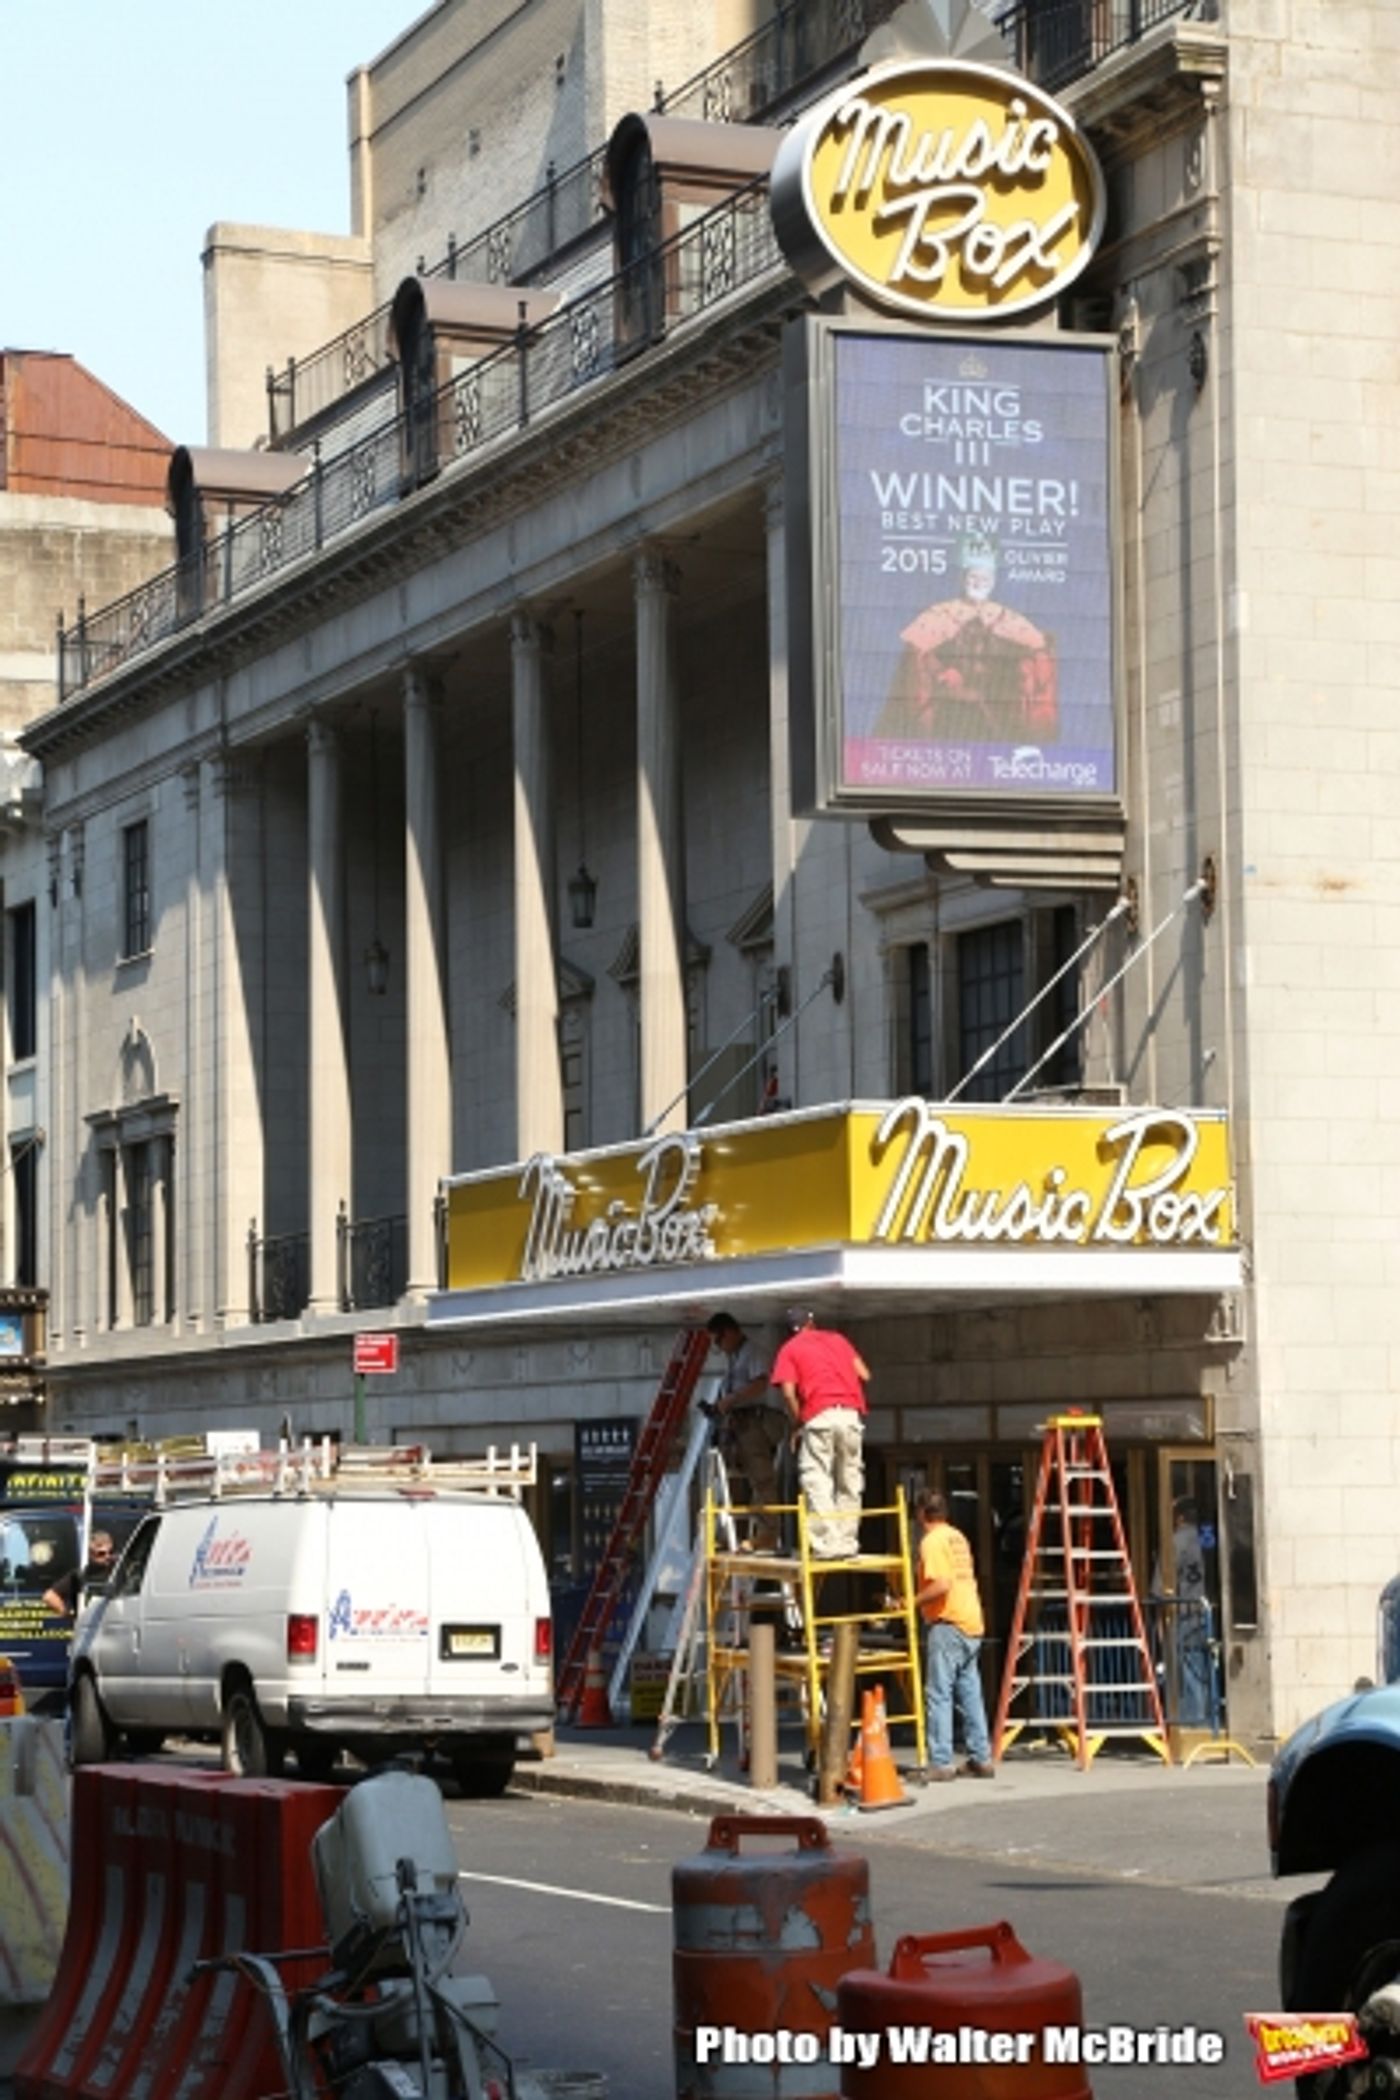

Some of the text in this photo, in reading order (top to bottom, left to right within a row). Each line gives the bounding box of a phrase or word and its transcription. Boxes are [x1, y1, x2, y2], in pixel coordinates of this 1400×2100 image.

[837, 98, 1057, 185] Music
[878, 184, 1080, 288] Box
[923, 384, 1021, 417] KING
[899, 412, 1044, 443] CHARLES
[954, 440, 990, 467] III
[870, 470, 1080, 516] WINNER!
[881, 511, 1066, 537] BEST NEW PLAY
[880, 547, 948, 575] 2015
[906, 762, 946, 779] NOW
[986, 745, 1098, 783] Telecharge
[878, 1096, 1228, 1241] Music Box
[518, 1134, 720, 1282] Music Box
